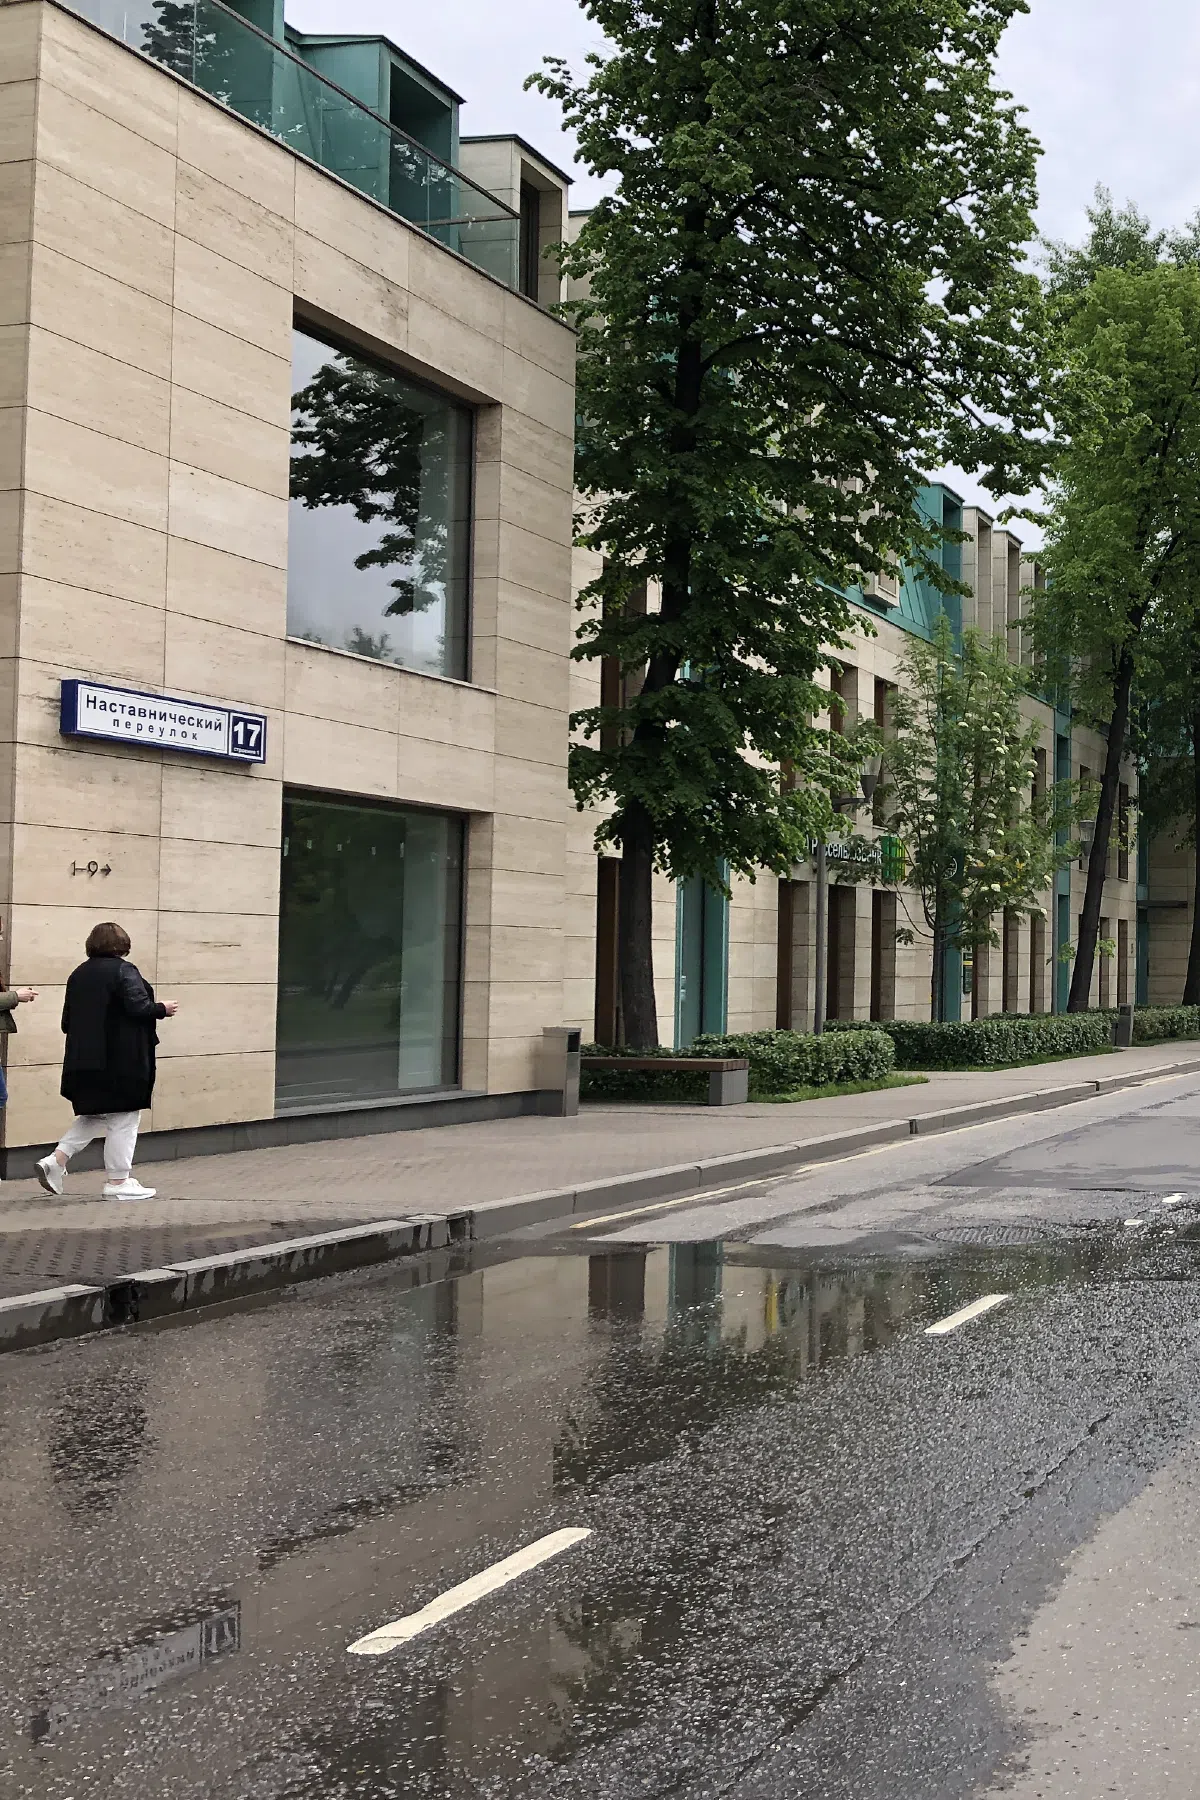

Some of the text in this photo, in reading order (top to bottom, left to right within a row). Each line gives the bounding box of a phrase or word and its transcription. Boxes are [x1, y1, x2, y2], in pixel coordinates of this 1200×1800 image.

[86, 694, 222, 732] Наставнический
[112, 718, 198, 741] переулок
[234, 721, 260, 747] 17
